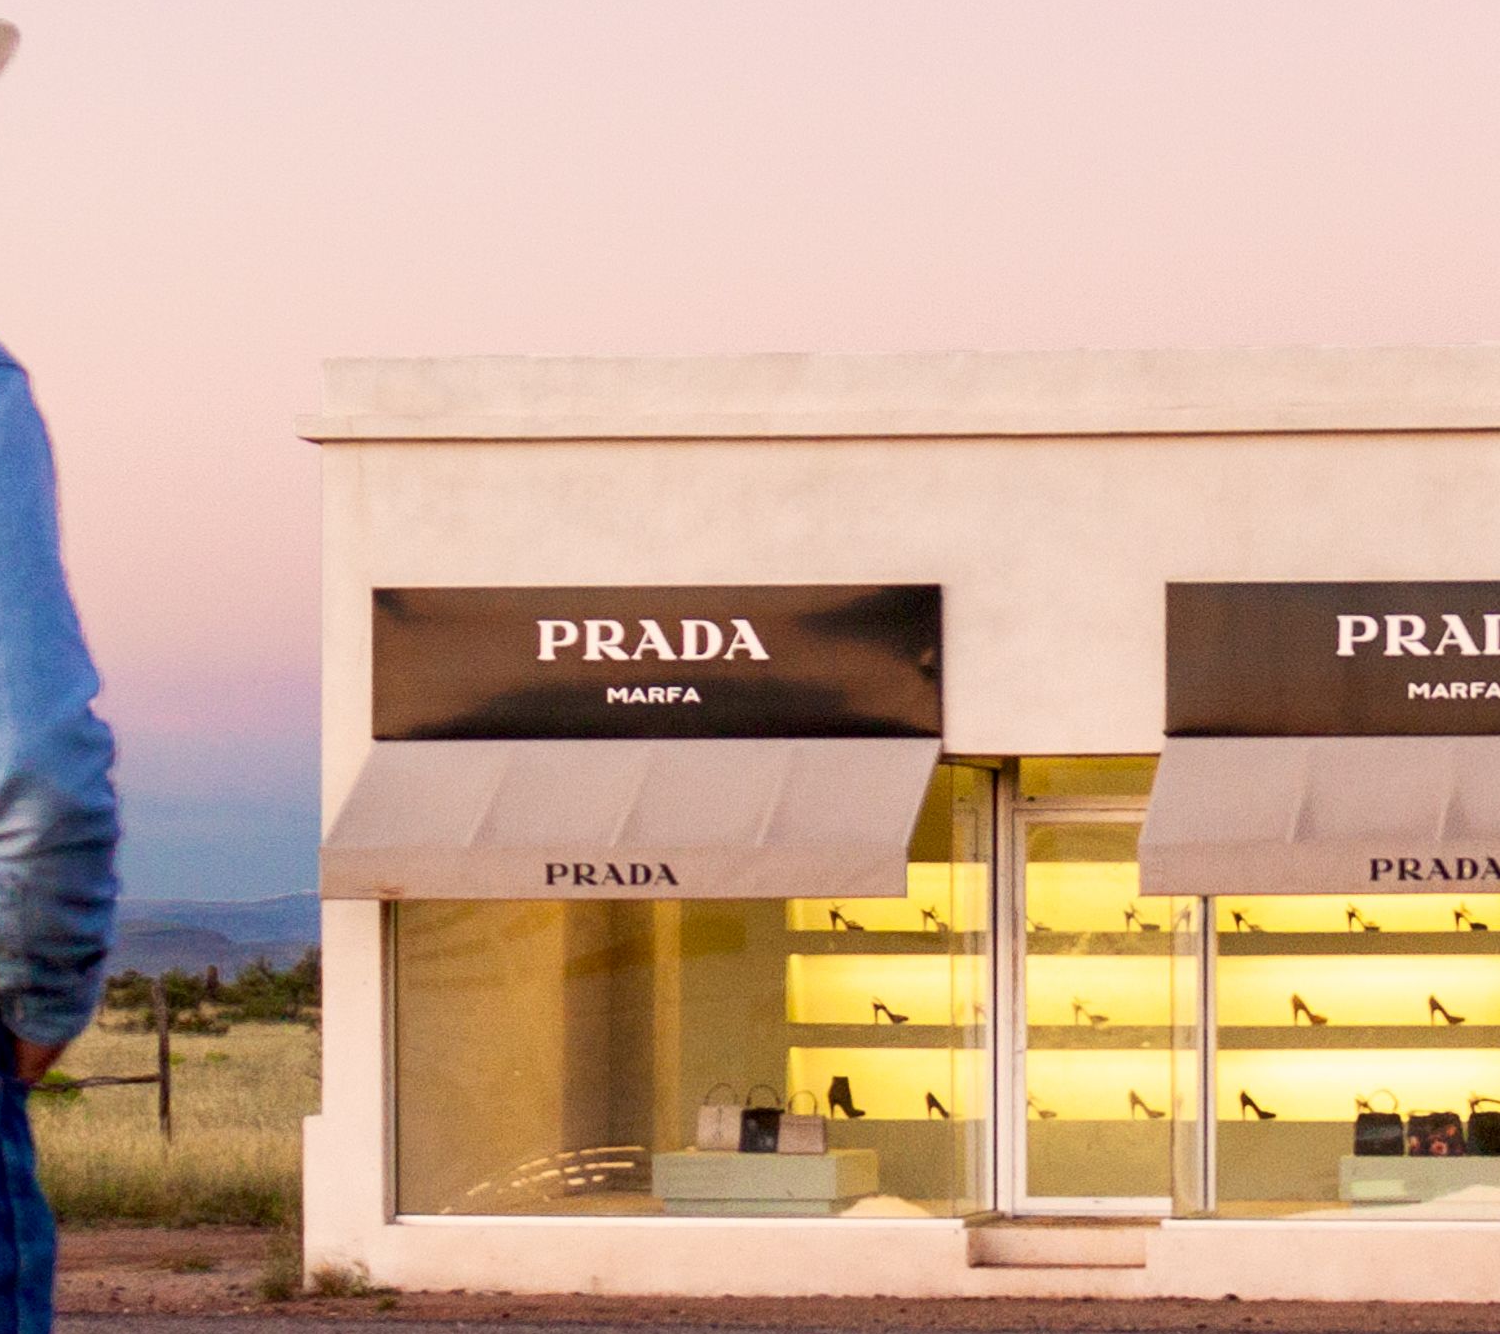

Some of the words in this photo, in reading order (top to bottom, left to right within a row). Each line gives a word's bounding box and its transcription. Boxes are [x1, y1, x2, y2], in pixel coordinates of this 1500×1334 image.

[536, 619, 770, 661] PRADA
[606, 686, 701, 704] MARFA
[546, 863, 679, 886] PRADA
